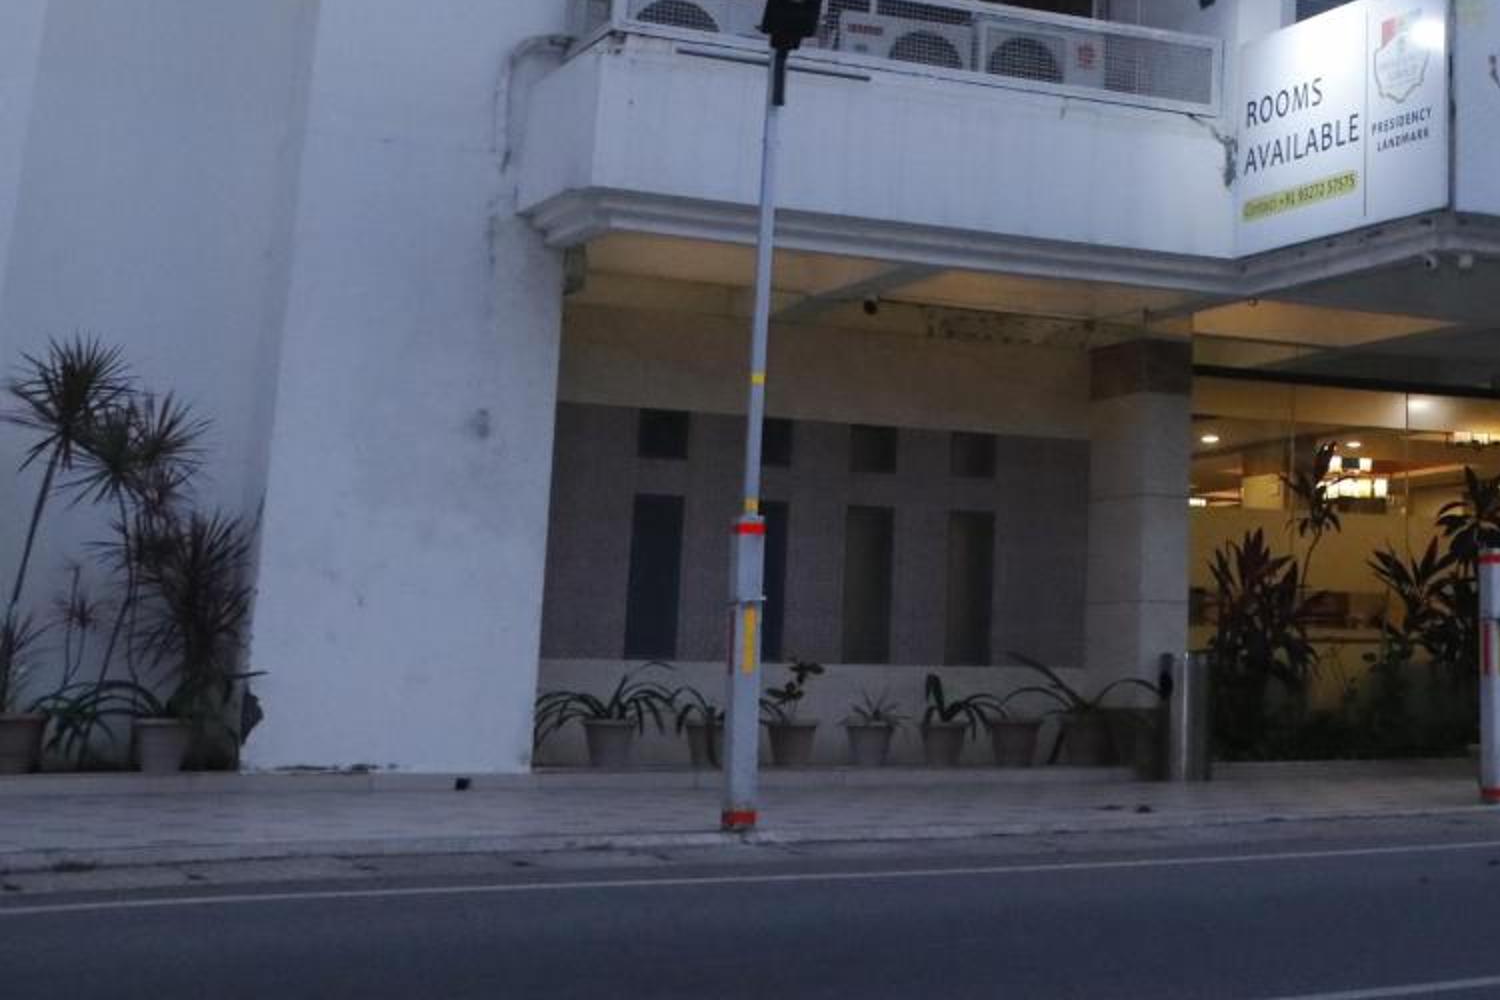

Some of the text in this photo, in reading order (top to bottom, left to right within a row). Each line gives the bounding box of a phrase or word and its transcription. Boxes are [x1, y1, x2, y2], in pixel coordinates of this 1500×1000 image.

[1246, 77, 1323, 129] ROOMS
[1371, 105, 1433, 137] PRESIDENCY
[1243, 113, 1360, 176] AVAILABLE
[1376, 127, 1430, 152] LANDMARK
